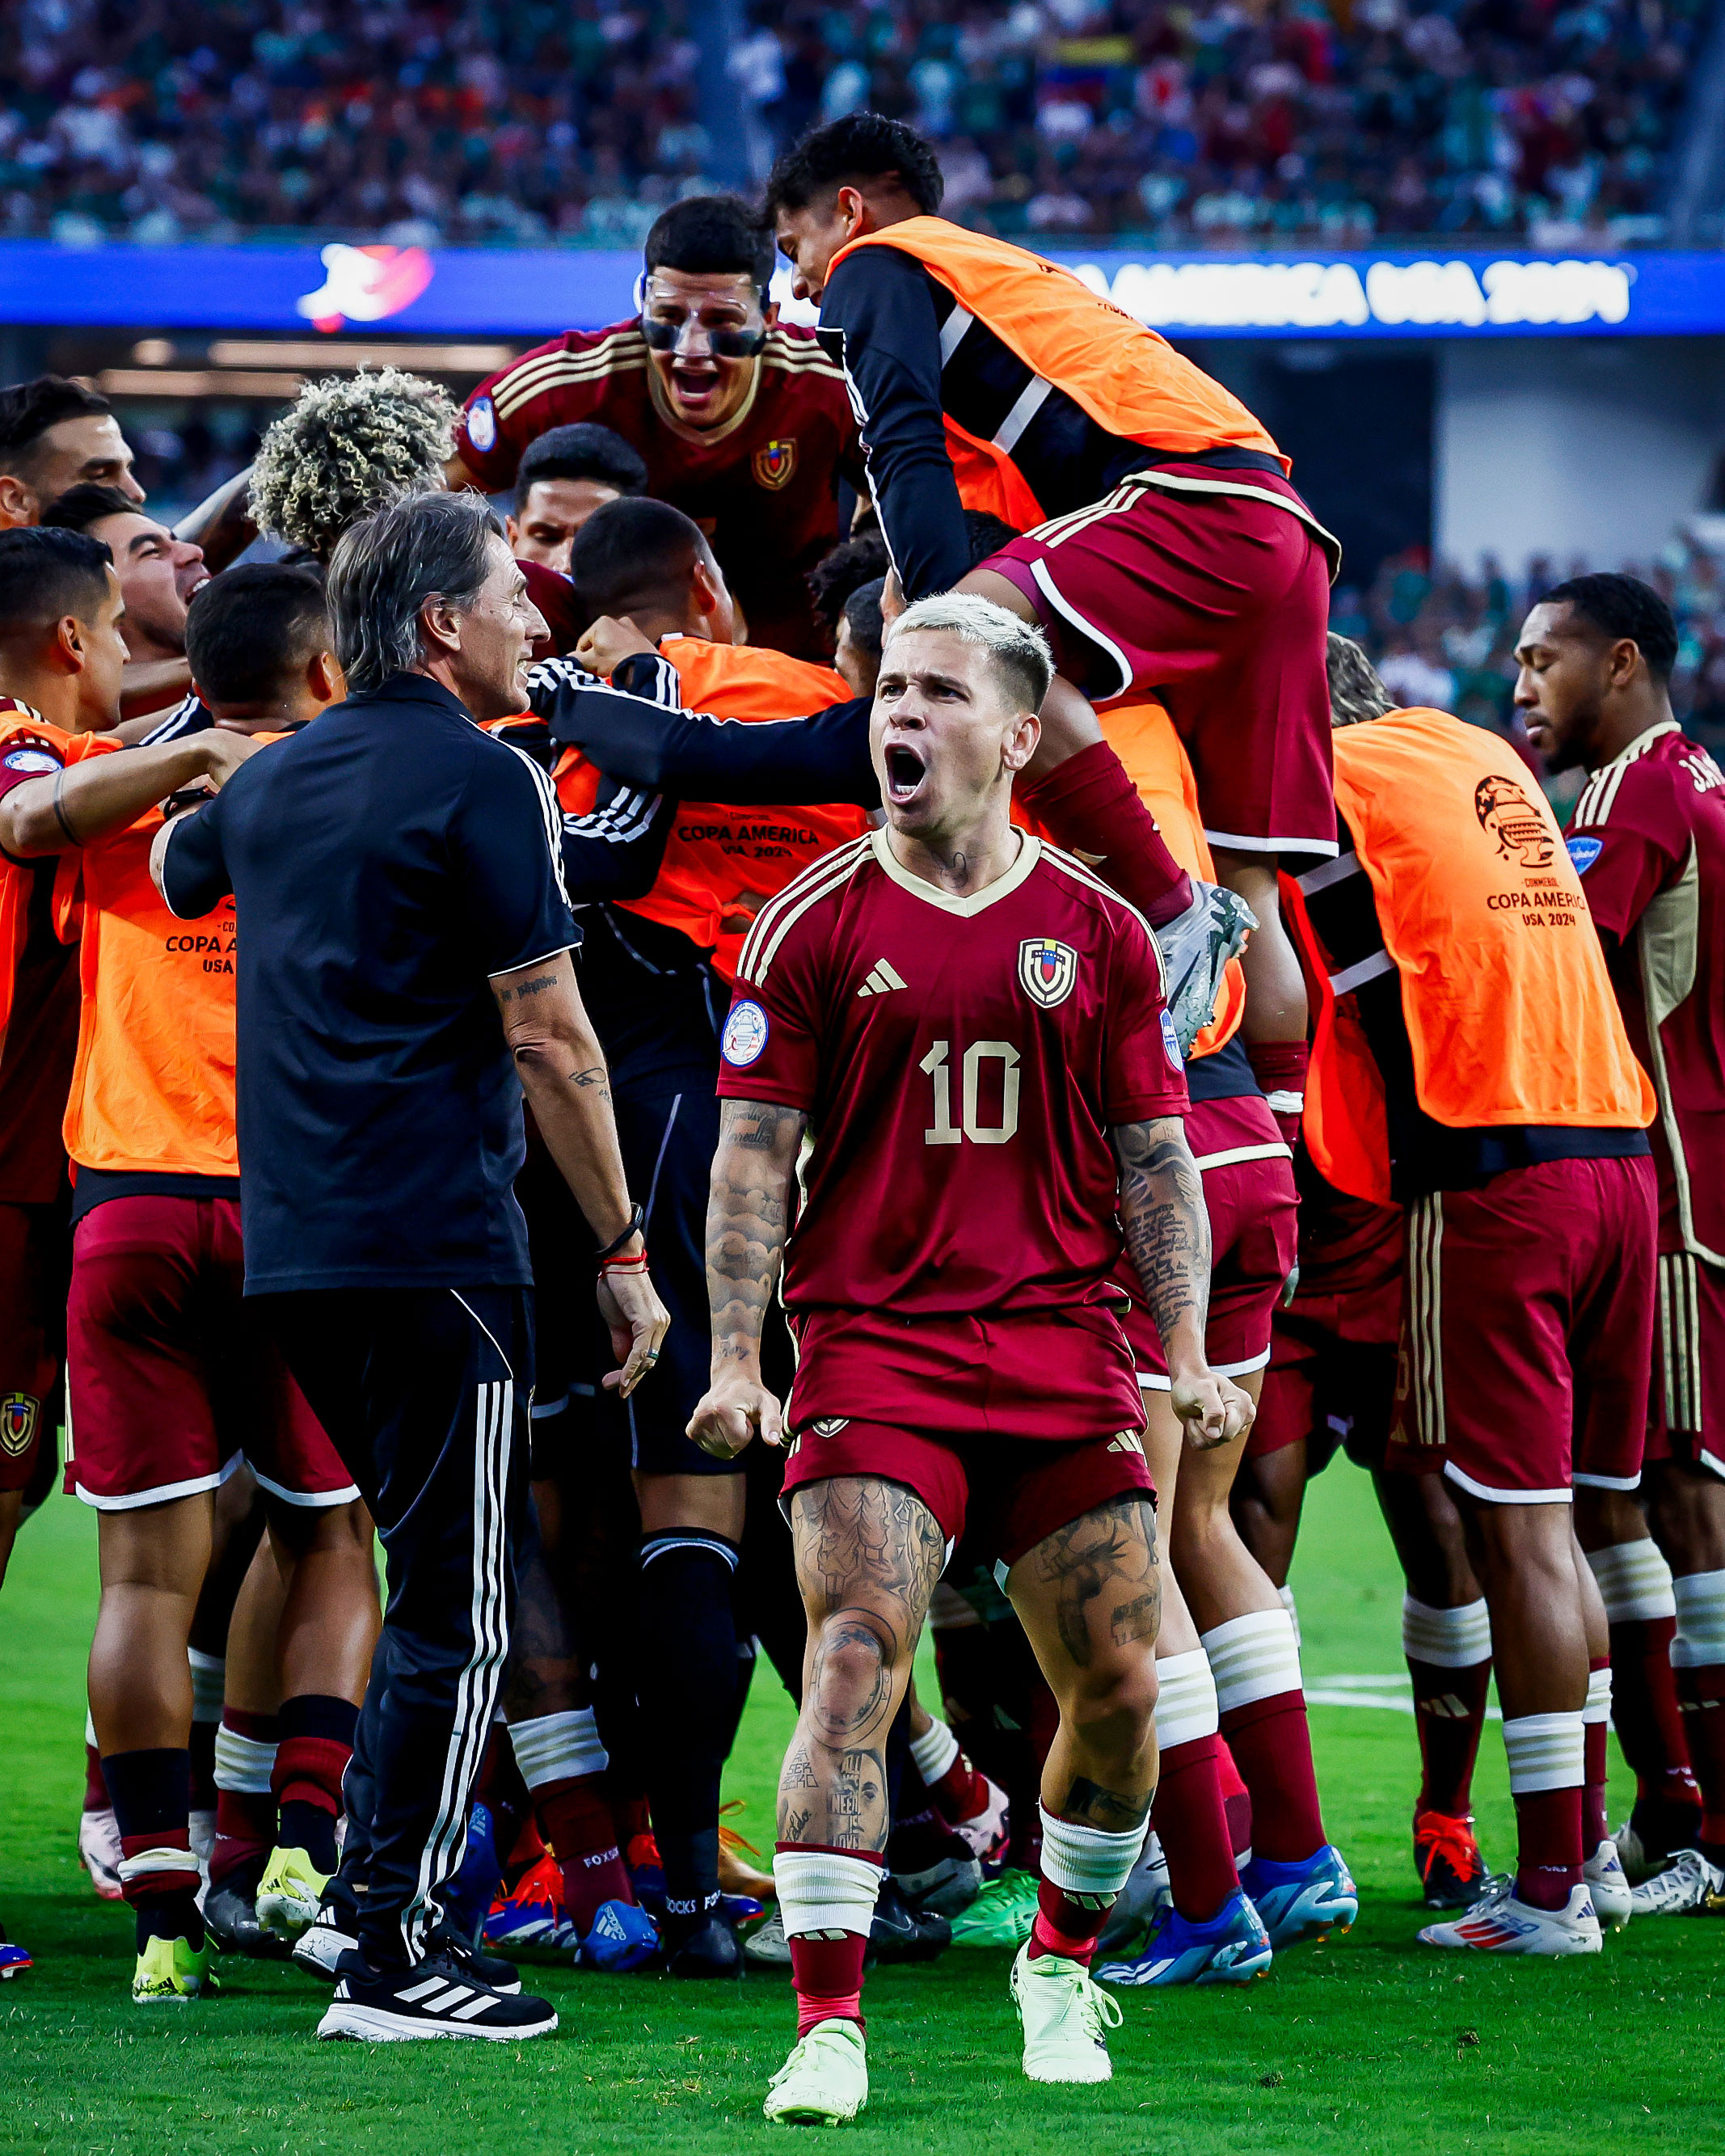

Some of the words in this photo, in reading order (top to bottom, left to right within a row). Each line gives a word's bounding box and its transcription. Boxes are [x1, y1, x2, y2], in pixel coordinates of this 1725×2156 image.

[678, 825, 732, 842] COPA
[737, 825, 819, 845] AMERICA
[1487, 892, 1532, 909] COPA
[1522, 913, 1546, 926] USA
[1549, 913, 1575, 926] 2024
[166, 936, 221, 952] COPA
[203, 960, 234, 974] USA
[919, 1040, 1020, 1145] 10
